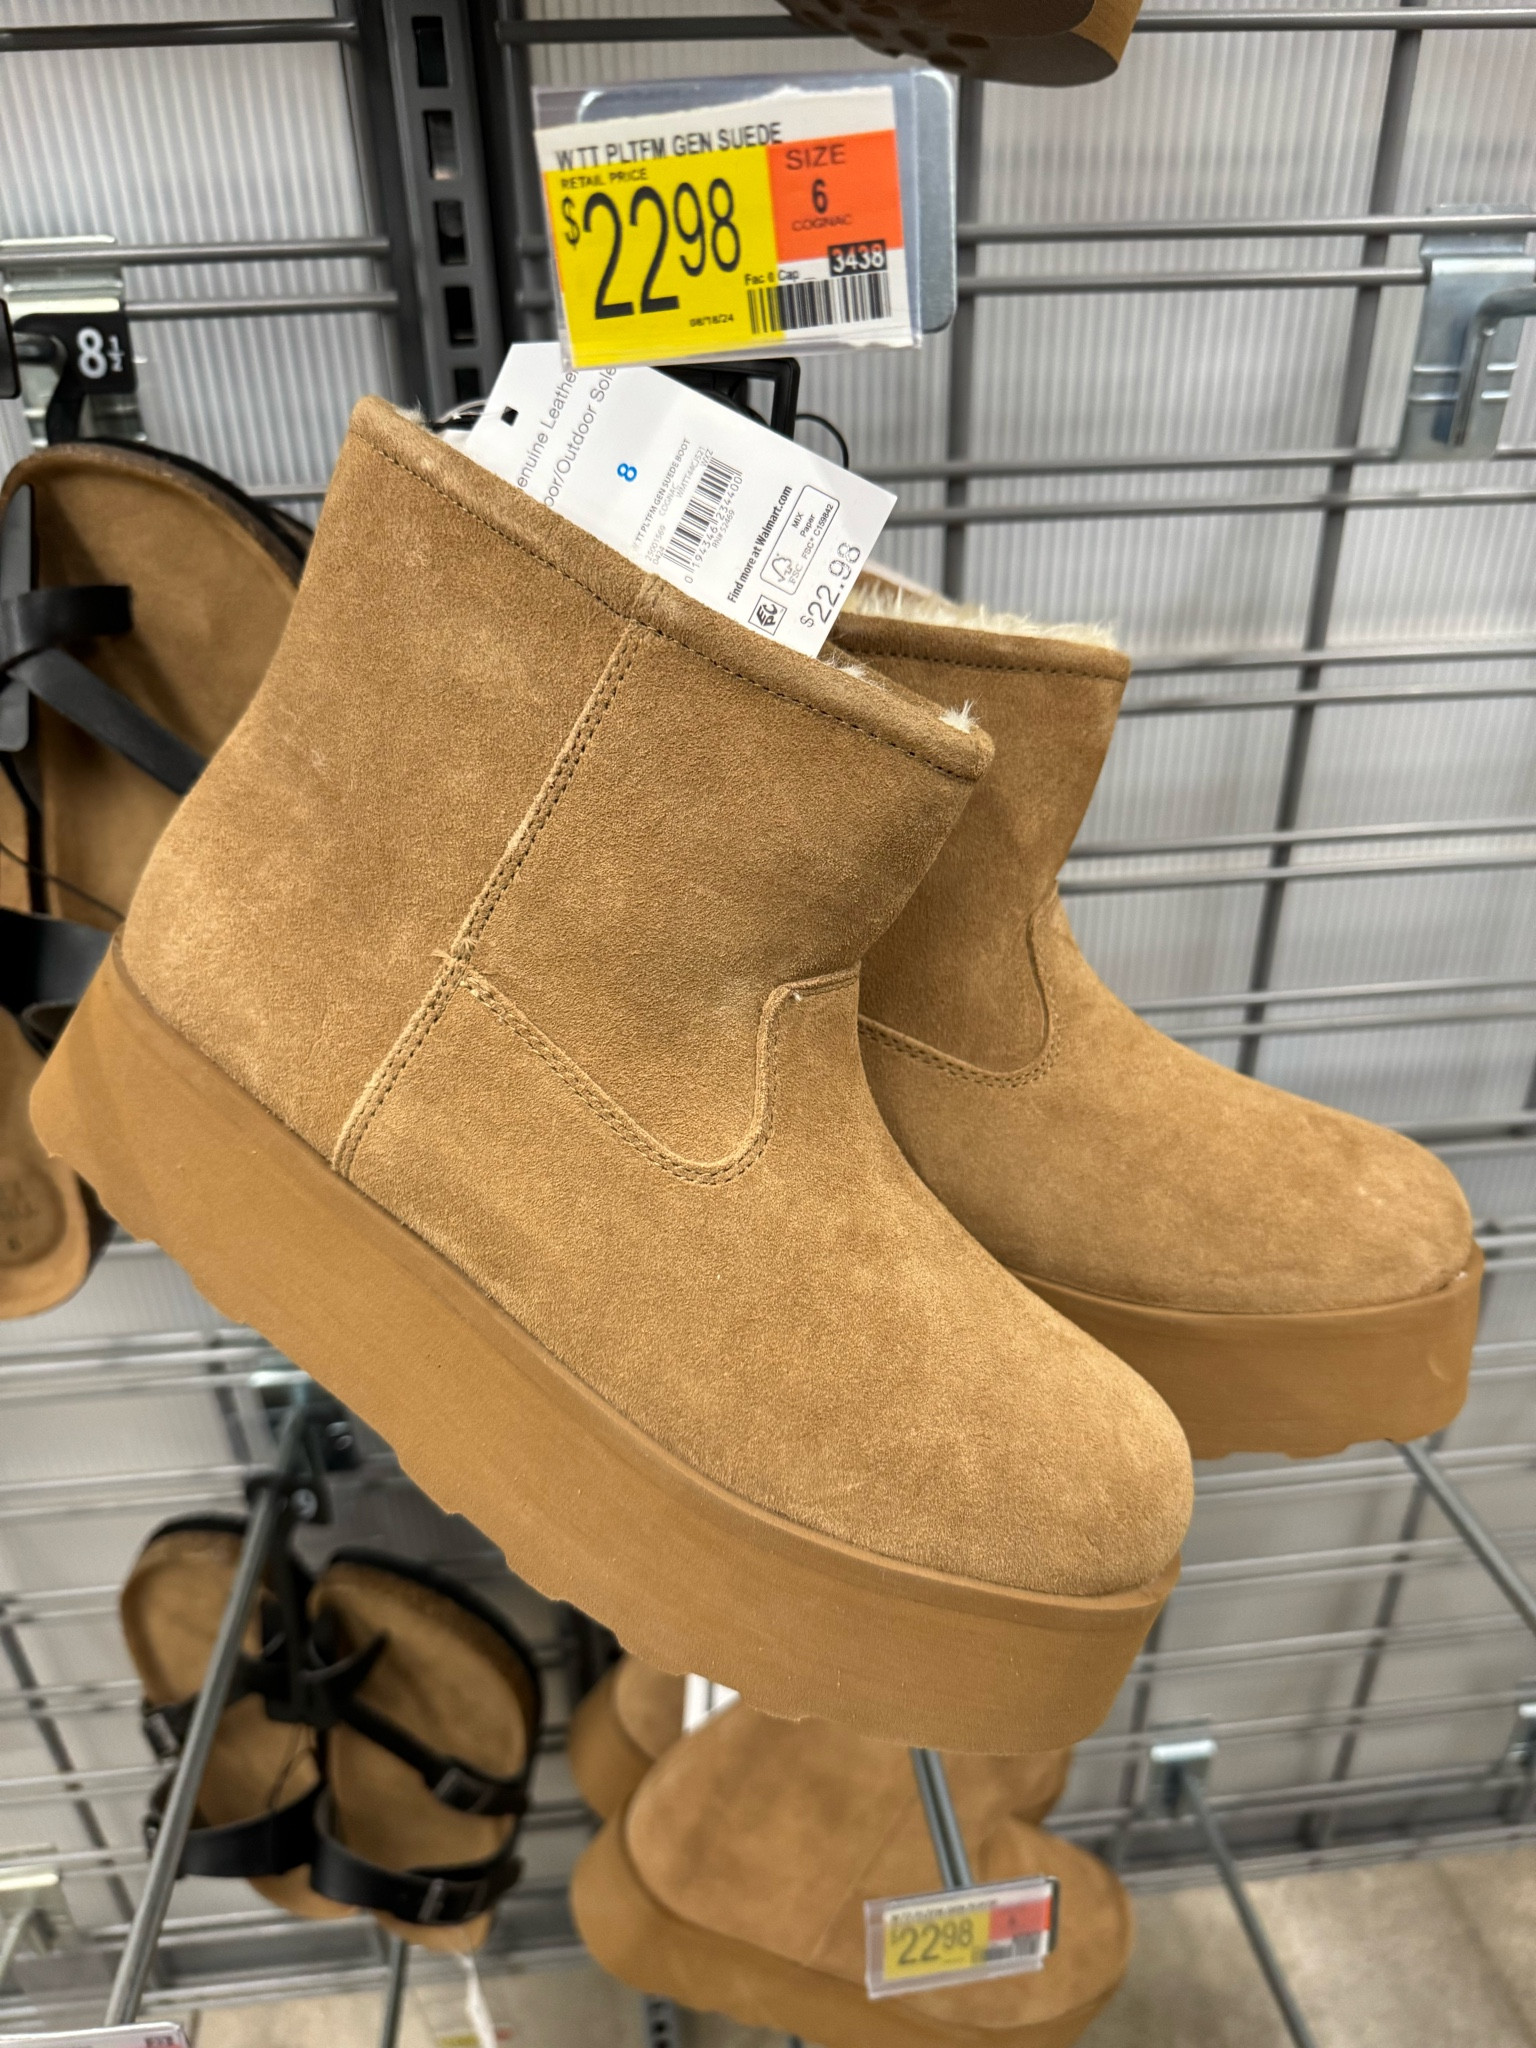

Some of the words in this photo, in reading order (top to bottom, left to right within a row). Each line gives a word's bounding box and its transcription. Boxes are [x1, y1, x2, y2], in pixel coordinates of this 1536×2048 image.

[606, 138, 667, 165] PLTFM
[672, 132, 714, 156] GEN
[718, 122, 783, 150] SUEDE
[785, 144, 846, 170] SIZE
[561, 174, 605, 190] RETAIL
[610, 168, 648, 183] PRICE
[812, 178, 829, 214] 6
[791, 214, 853, 231] COGNAC
[831, 243, 886, 274] 3438
[744, 273, 764, 286] Fac
[778, 269, 800, 283] Cap
[544, 404, 598, 508] oor/Outdoor
[590, 367, 617, 403] Sole
[517, 432, 549, 488] enuine
[617, 462, 638, 483] 8
[640, 505, 658, 532] PLTFM
[653, 487, 666, 506] GEN
[662, 461, 680, 489] SUEDE
[674, 438, 690, 462] BOOT
[659, 481, 680, 516] COGNAC
[691, 525, 718, 568] 194346
[716, 476, 743, 520] 234400
[755, 485, 793, 548] Walmart.com
[791, 511, 804, 529] MIX
[800, 514, 816, 537] Paper
[813, 503, 834, 537] C159842
[753, 546, 763, 559] at
[740, 557, 757, 583] more
[788, 563, 804, 586] FSC
[727, 580, 744, 603] Find
[800, 542, 861, 628] $22.98
